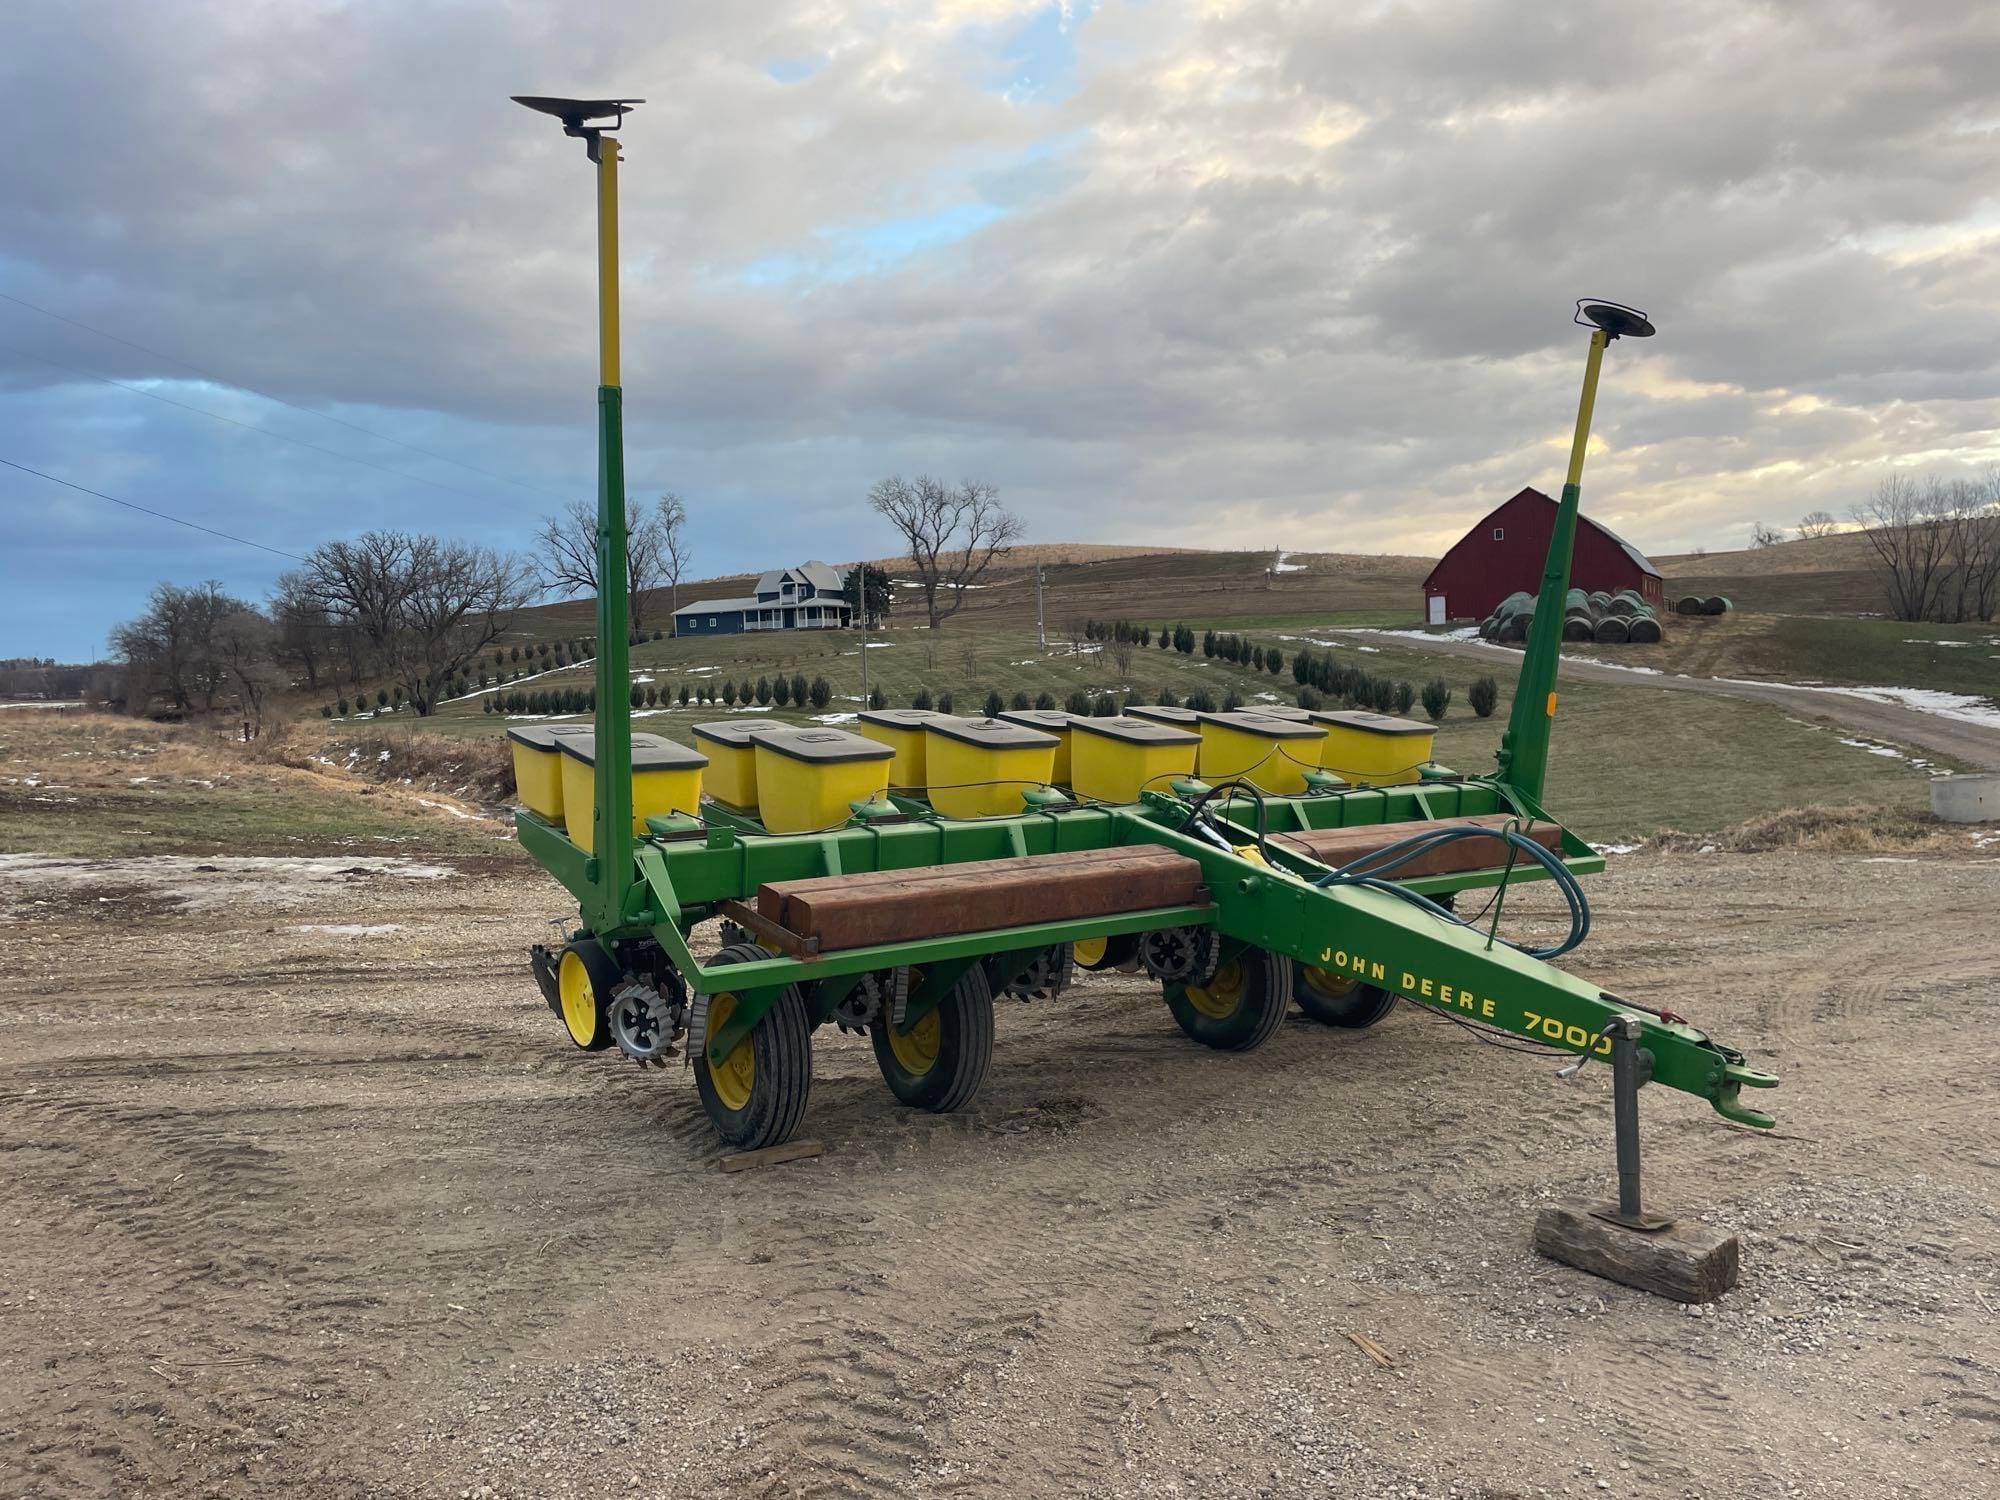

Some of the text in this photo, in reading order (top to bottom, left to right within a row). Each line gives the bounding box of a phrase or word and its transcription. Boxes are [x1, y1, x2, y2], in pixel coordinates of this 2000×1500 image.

[1321, 947, 1613, 1055] JOHN DEERE 7000
